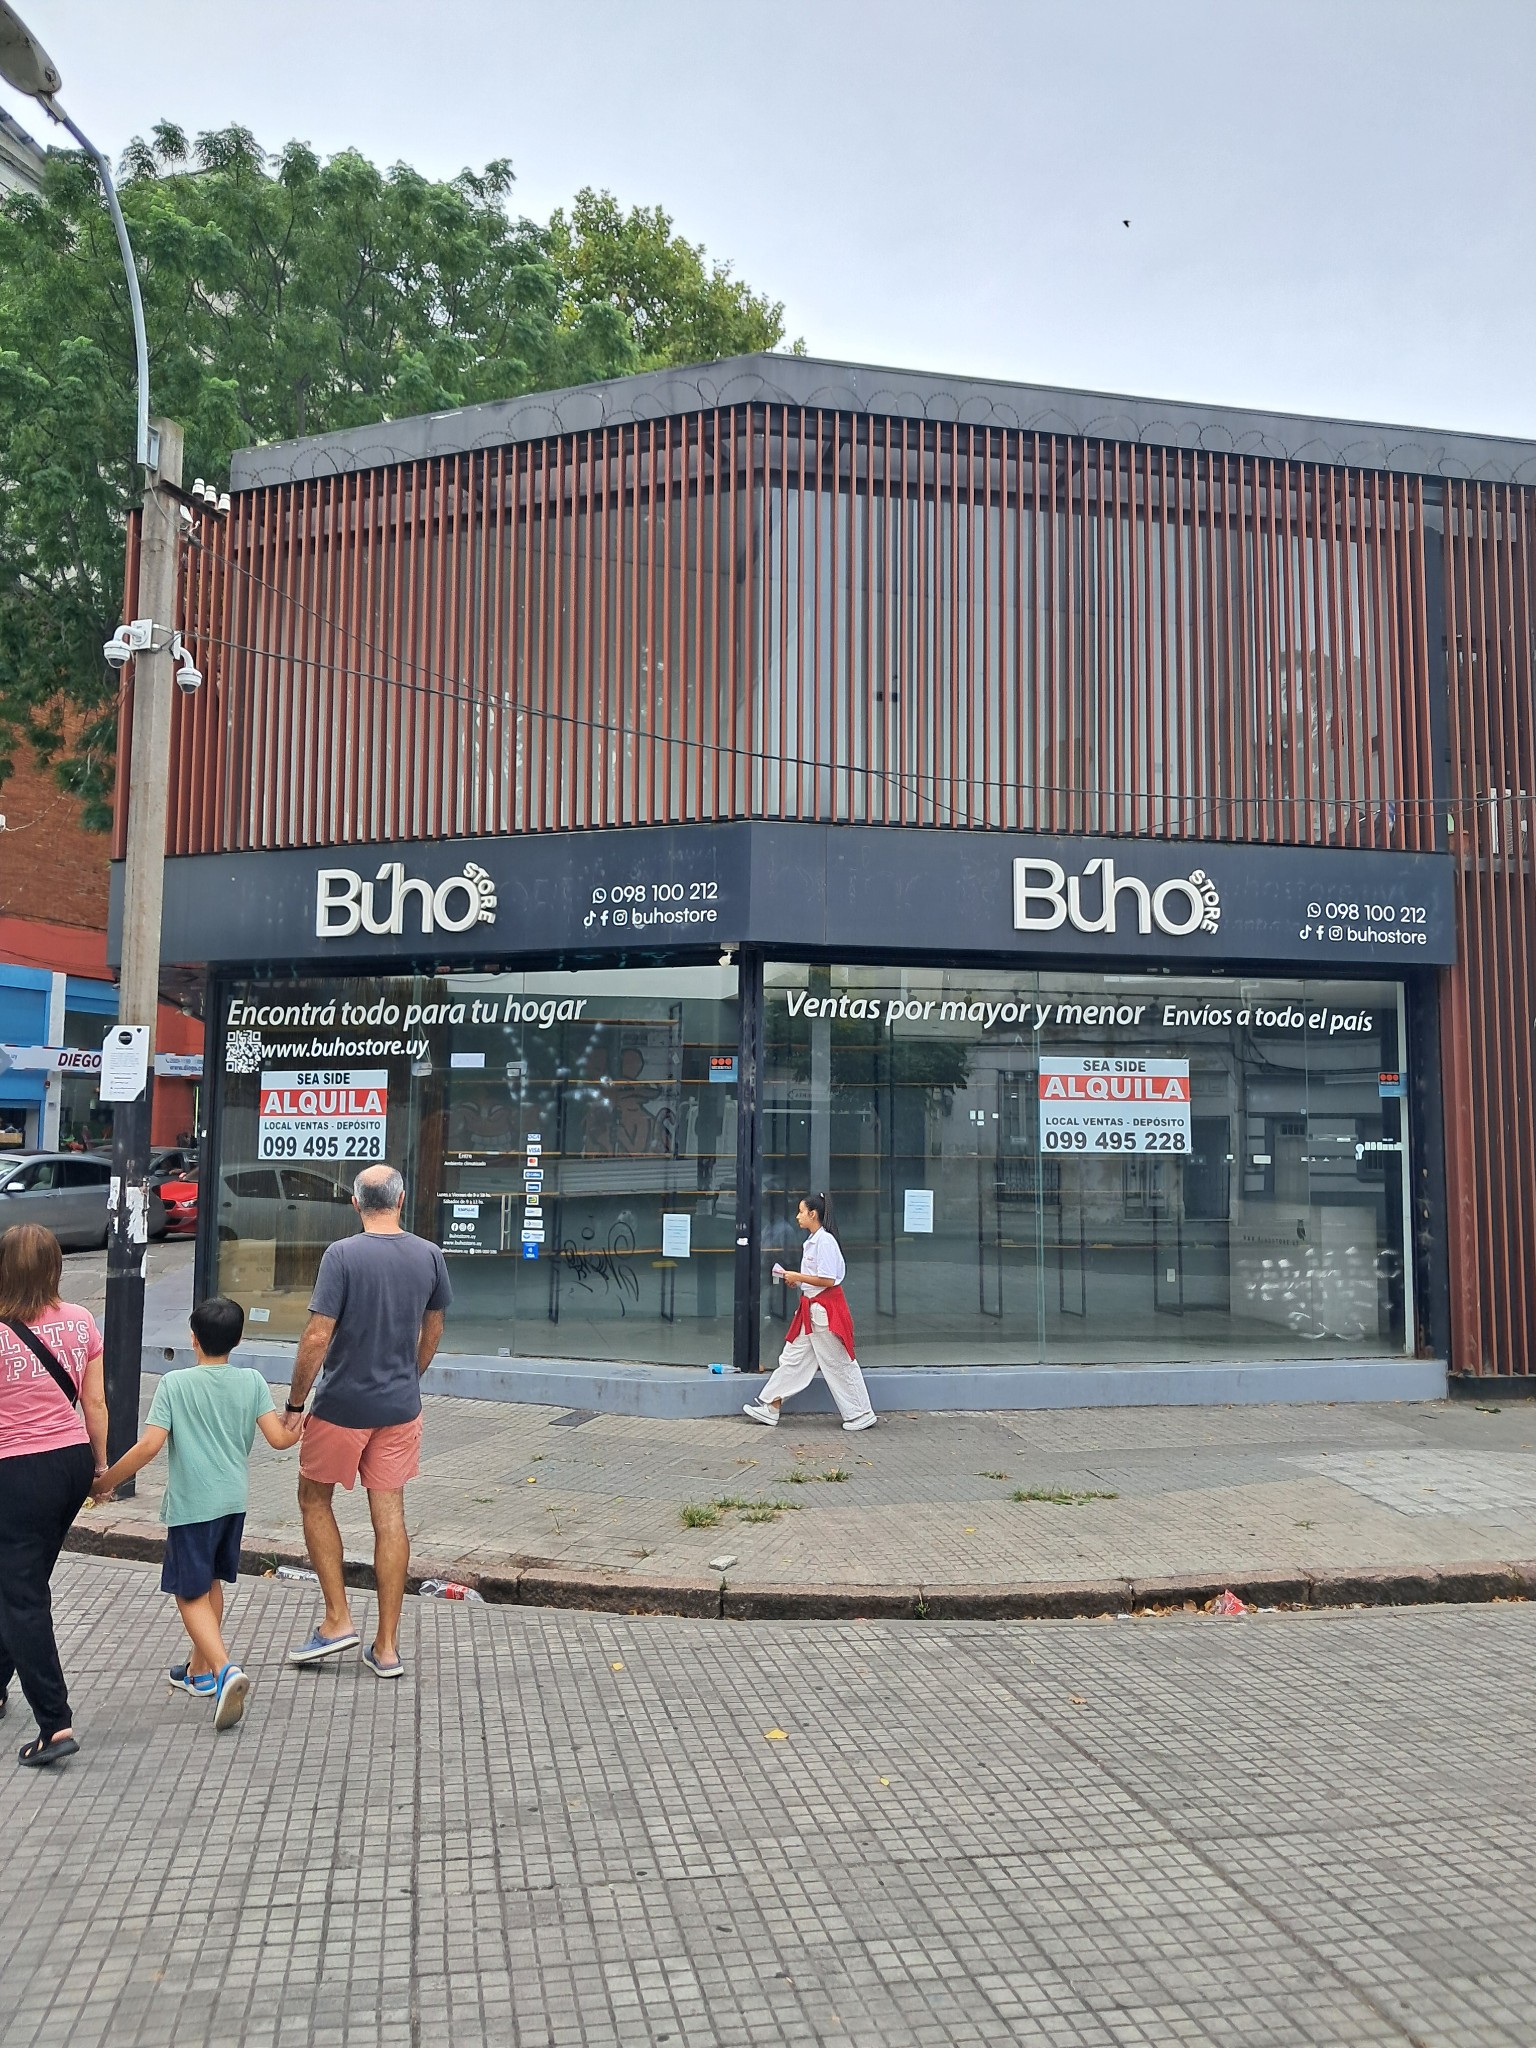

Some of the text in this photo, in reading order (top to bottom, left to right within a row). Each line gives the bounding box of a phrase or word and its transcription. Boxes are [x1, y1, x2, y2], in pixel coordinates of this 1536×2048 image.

[316, 862, 497, 937] Búho STORE
[611, 882, 718, 903] 098 100 212
[1013, 858, 1221, 936] Búho STORE
[632, 907, 717, 924] buhostore
[1325, 903, 1426, 923] 098 100 212
[1347, 925, 1427, 945] buhostore
[227, 995, 587, 1031] Encontrá todo para tu hogar
[786, 991, 1373, 1035] Ventas por mayor y menor Envíos a todo el país
[262, 1037, 429, 1060] www.buhostore.uy
[58, 1053, 101, 1068] DIEGO
[1083, 1060, 1146, 1072] SEA SIDE
[297, 1072, 350, 1085] SEA SIDE
[1044, 1076, 1185, 1100] ALQUILA
[263, 1090, 382, 1115] ALQUILA
[264, 1121, 292, 1130] LOCAL
[295, 1121, 329, 1130] VENTAS
[336, 1119, 381, 1130] DEPÓSITO
[1045, 1117, 1079, 1126] LOCAL
[1083, 1117, 1124, 1126] VENTAS
[1133, 1116, 1184, 1127] DEPÓSITO
[263, 1136, 380, 1157] 099 495 228
[1045, 1131, 1185, 1151] 099 495 228
